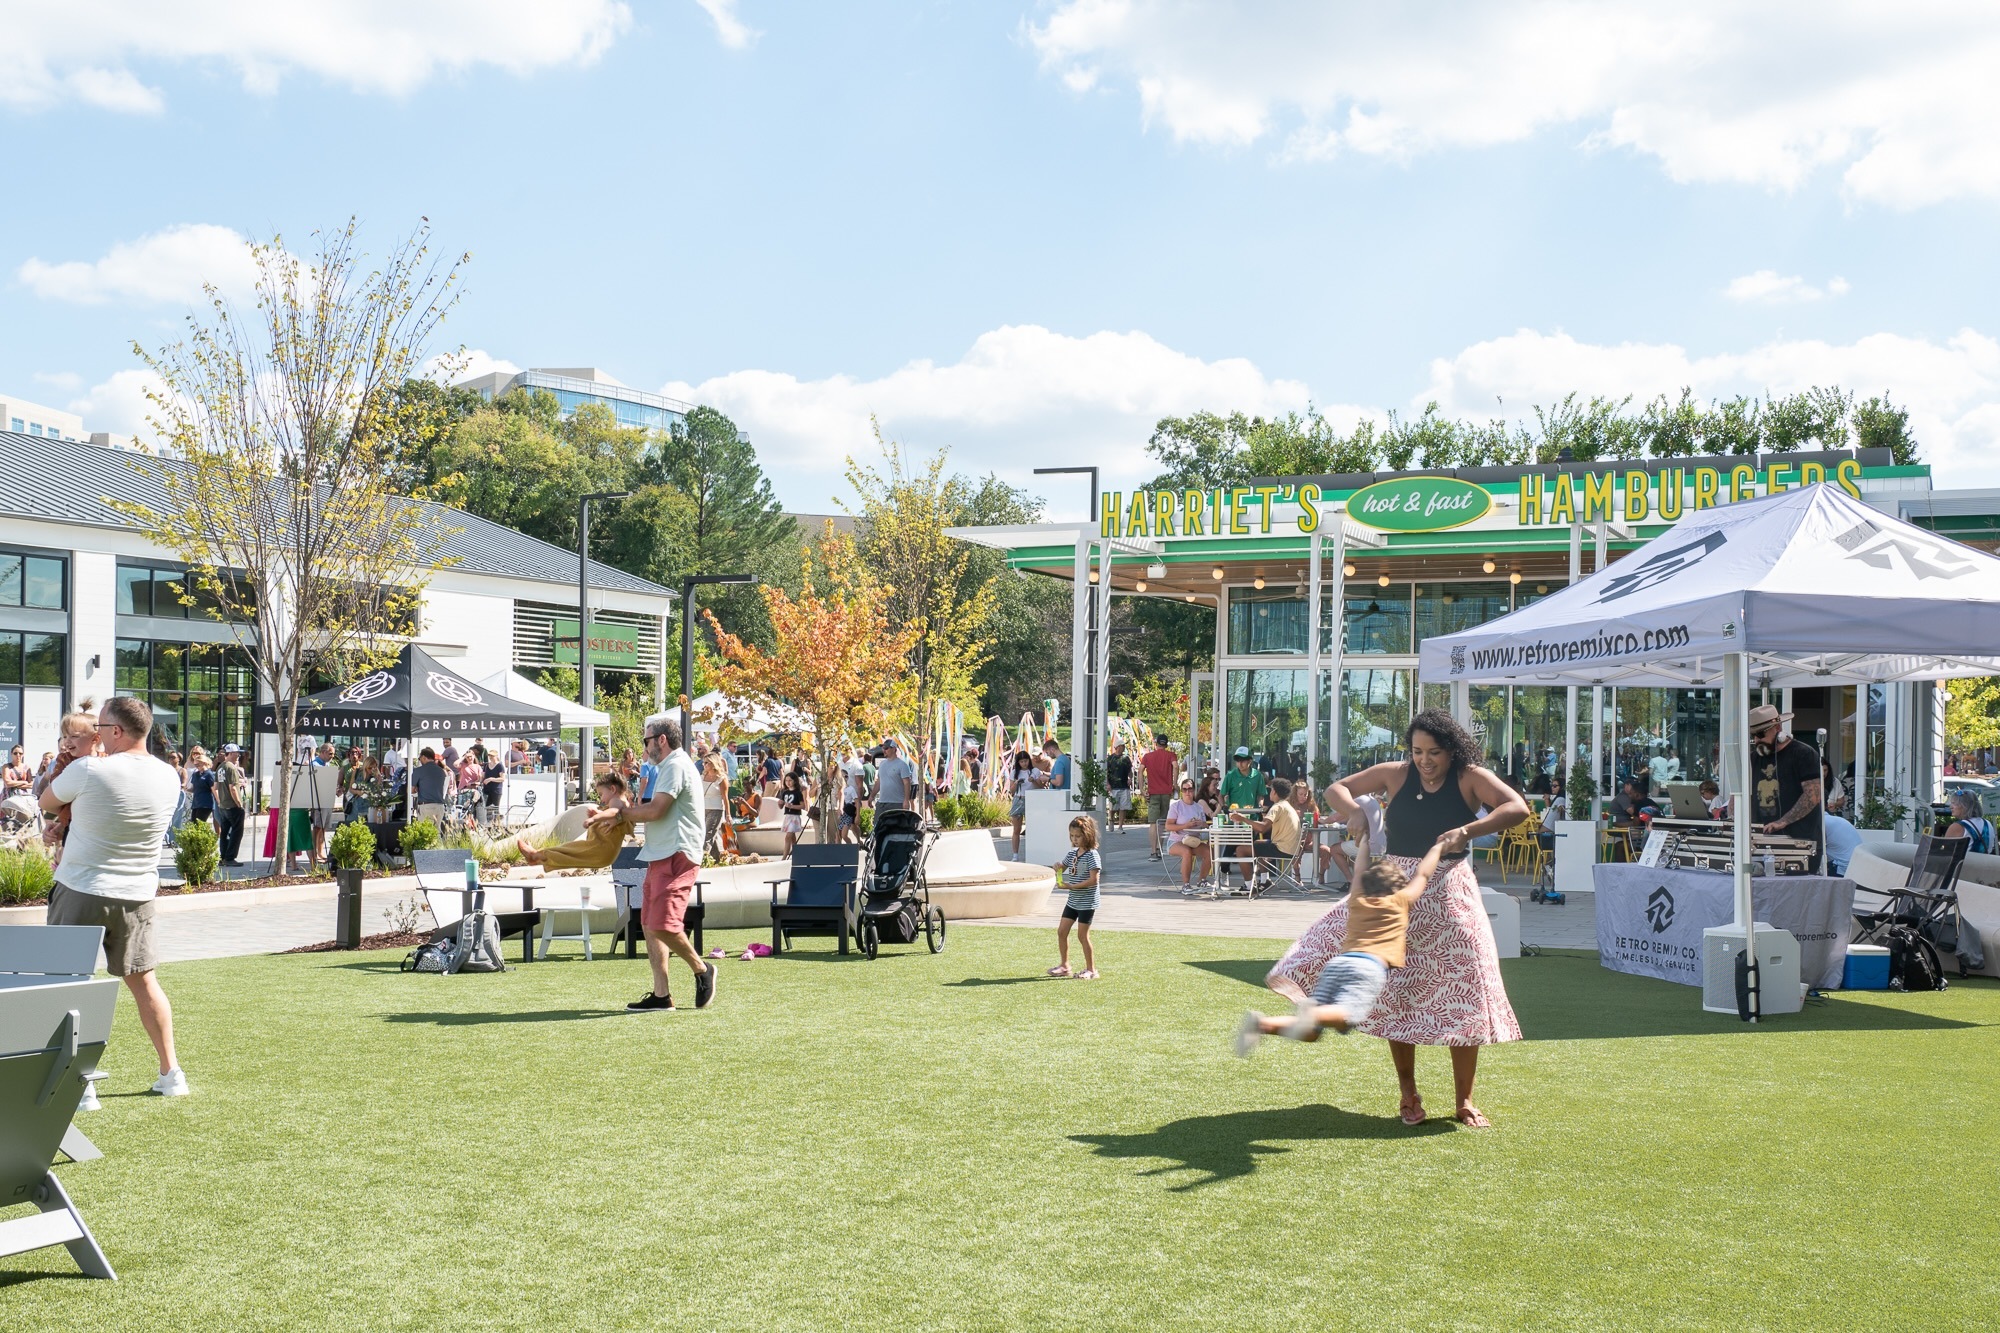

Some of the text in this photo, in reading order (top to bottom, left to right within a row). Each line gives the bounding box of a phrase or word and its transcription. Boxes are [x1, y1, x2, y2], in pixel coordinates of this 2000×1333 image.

[1101, 483, 1320, 538] HARRIET'S
[1363, 490, 1473, 517] hot & fast
[1472, 624, 1690, 671] www.retroremixco.com
[303, 717, 401, 730] BALLANTYNE
[420, 719, 553, 730] ORO BALLANTYNE
[1615, 936, 1700, 961] RETRO REMIX CO.
[1665, 960, 1696, 972] SERVICE
